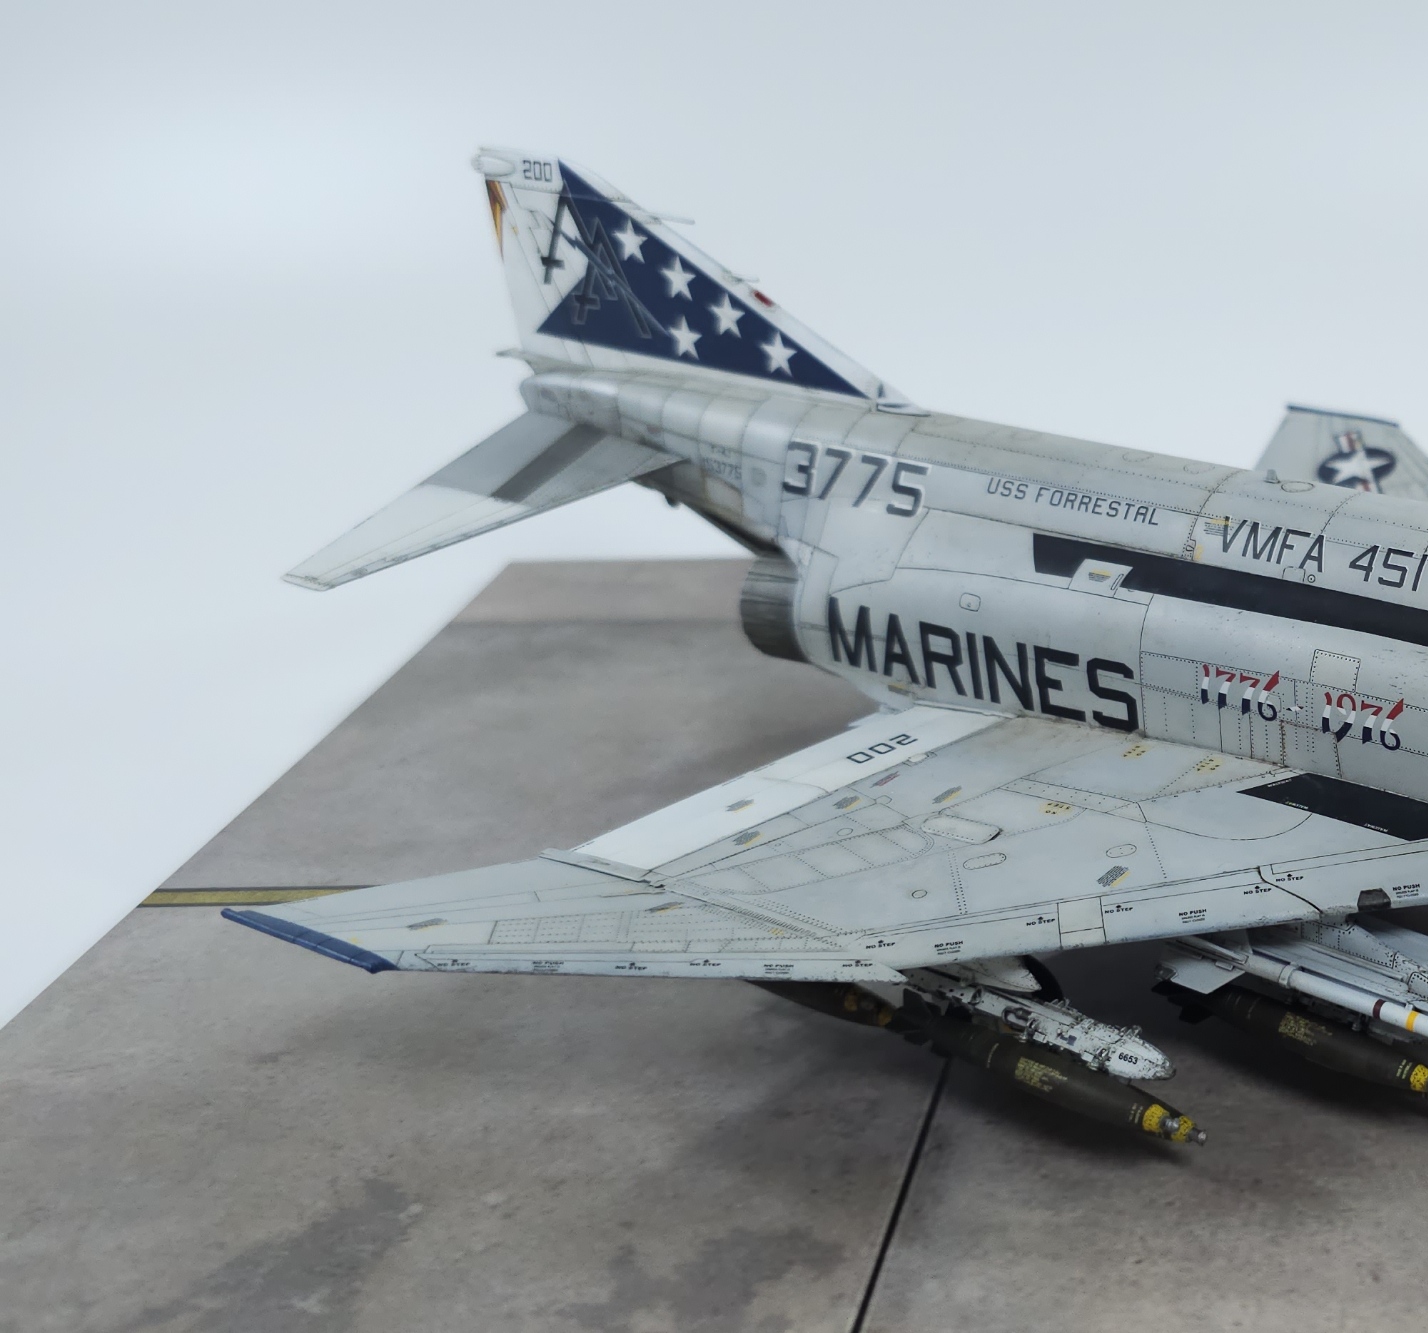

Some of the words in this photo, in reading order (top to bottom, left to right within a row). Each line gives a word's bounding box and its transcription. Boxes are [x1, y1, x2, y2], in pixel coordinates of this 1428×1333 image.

[522, 159, 553, 182] 200
[781, 439, 931, 518] 3775
[986, 477, 1029, 500] USS
[1034, 486, 1159, 526] FORRESTAL
[1222, 515, 1327, 573] VMFA
[1348, 544, 1428, 592] 451
[828, 596, 1140, 733] MARINES
[1201, 663, 1280, 722] 1776
[1321, 691, 1405, 751] 1976
[1118, 1052, 1139, 1065] 6653
